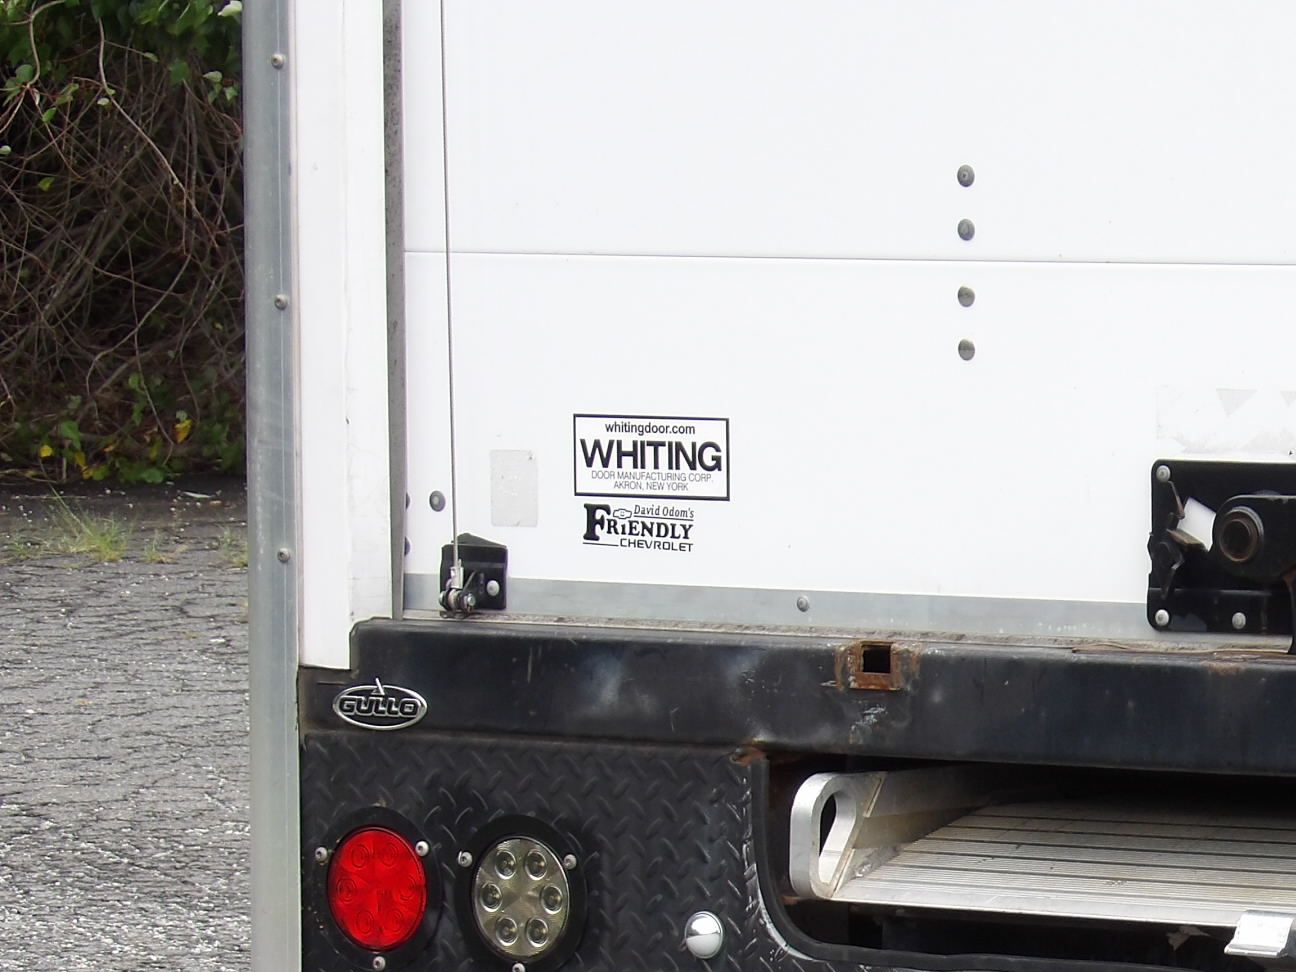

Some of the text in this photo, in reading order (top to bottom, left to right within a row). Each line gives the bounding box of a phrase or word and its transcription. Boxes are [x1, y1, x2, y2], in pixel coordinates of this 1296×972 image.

[605, 421, 696, 436] whitingdoor.com
[580, 438, 722, 472] WHITING
[591, 471, 713, 482] DOOR MANUFACTURING CORP.
[614, 481, 689, 491] AKRON, NEW YORK
[634, 504, 694, 518] David Odom's
[620, 538, 693, 552] CHEVROLET
